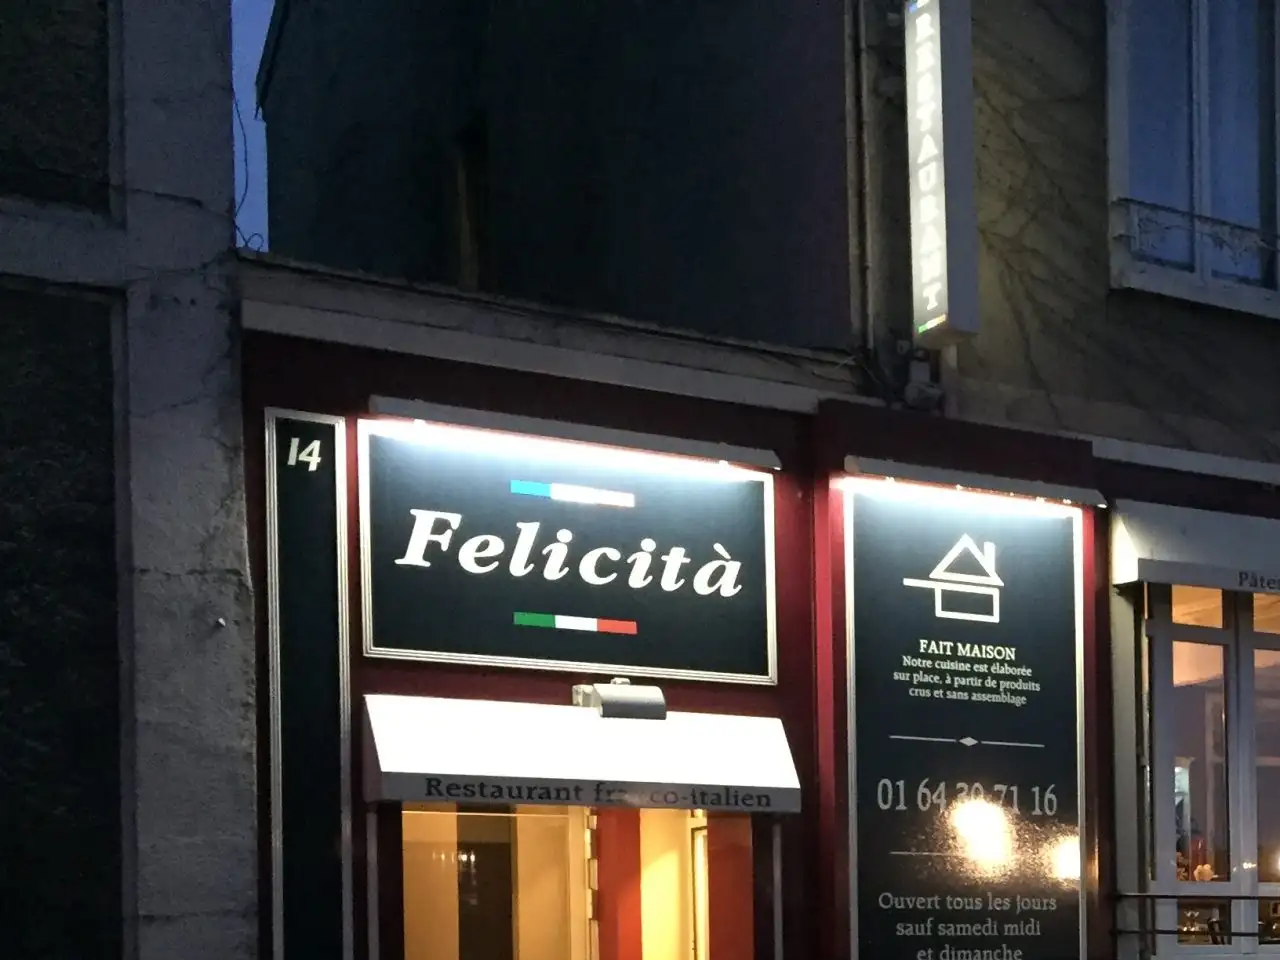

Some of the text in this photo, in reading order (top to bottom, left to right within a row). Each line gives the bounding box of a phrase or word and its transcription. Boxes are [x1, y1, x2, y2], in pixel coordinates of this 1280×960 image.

[915, 12, 942, 312] RESTAURANT
[287, 437, 322, 472] 14
[394, 507, 743, 598] Felicità
[919, 639, 1016, 661] FAIT MAISON
[902, 655, 1032, 677] Notre cuisine est élaborée
[893, 672, 910, 681] sur
[945, 673, 951, 684] à
[954, 675, 982, 688] partir
[985, 676, 997, 688] de
[999, 679, 1041, 692] produits
[909, 687, 1027, 707] crus et sans assemblage
[424, 776, 772, 808] Restaurant frco-italien
[877, 777, 908, 811] 01
[916, 777, 947, 811] 64
[993, 784, 1021, 815] 71
[1031, 783, 1058, 816] 16
[878, 892, 1057, 915] Ouvert tous les jours
[895, 917, 1041, 937] sauf samedi midi
